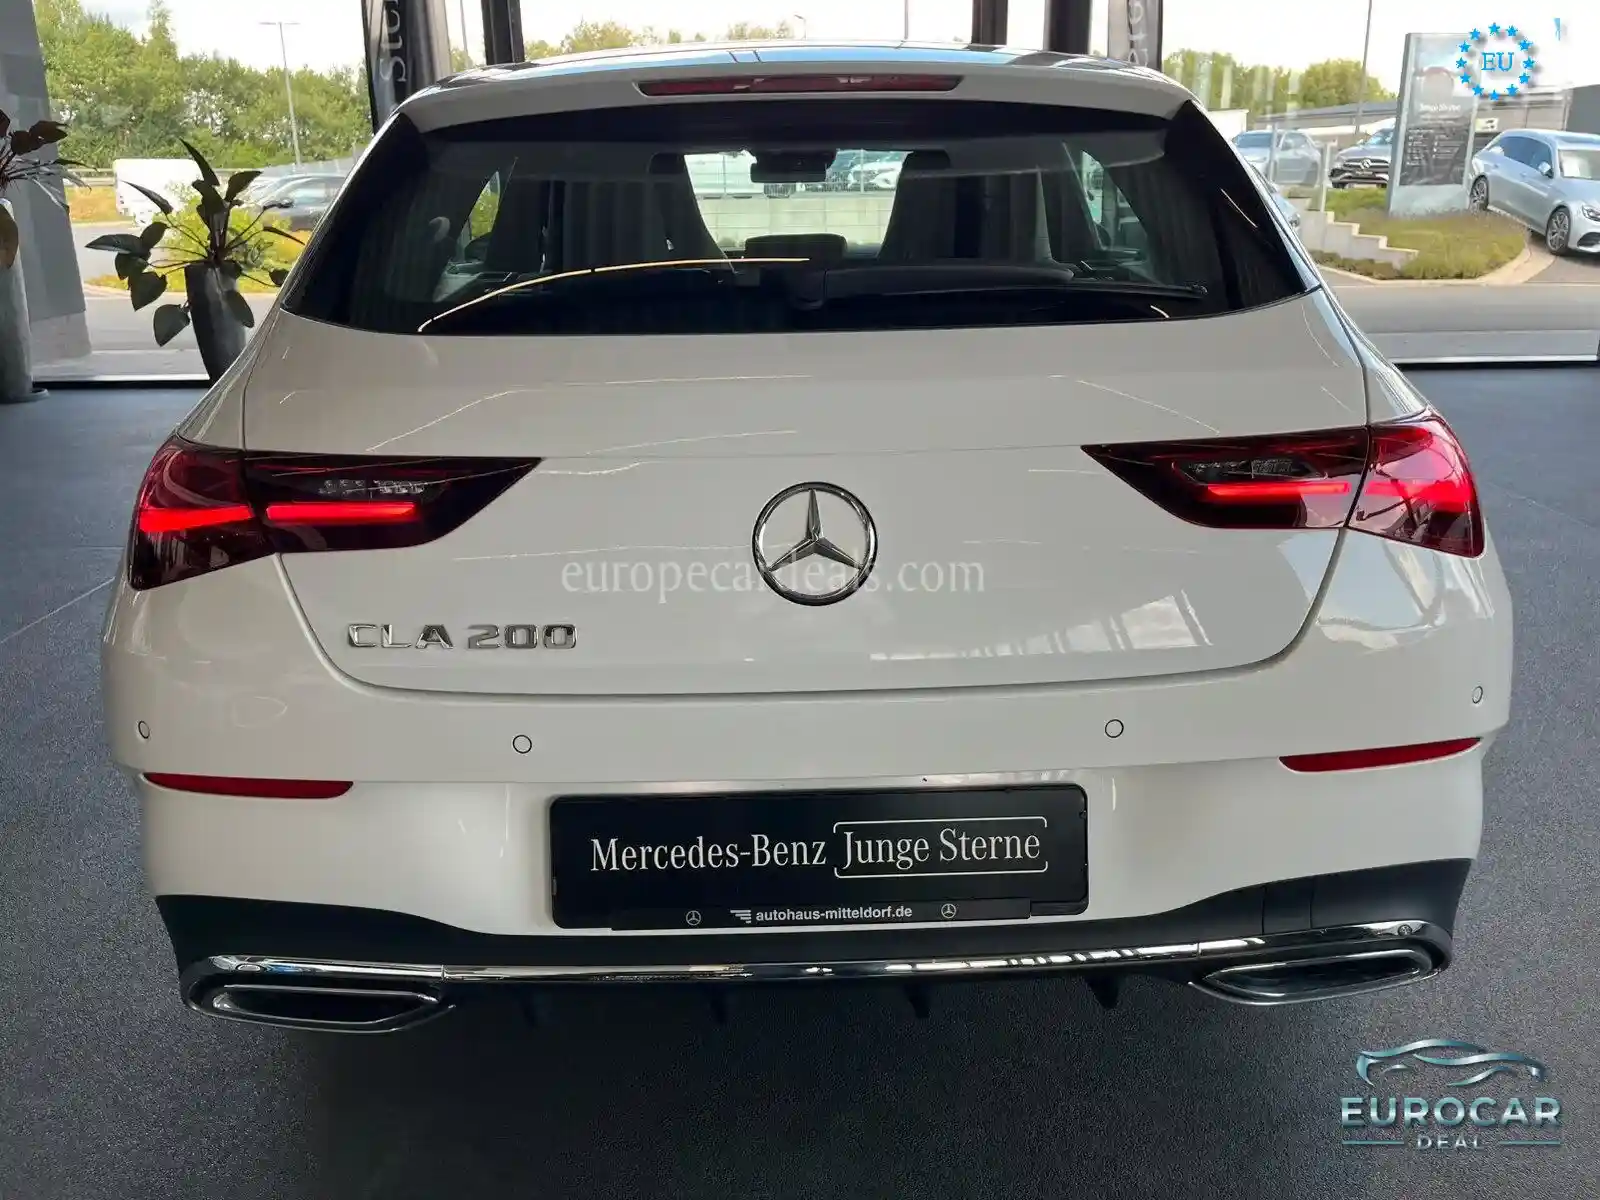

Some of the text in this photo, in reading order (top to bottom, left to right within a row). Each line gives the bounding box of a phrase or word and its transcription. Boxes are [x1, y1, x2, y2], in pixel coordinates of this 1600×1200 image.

[379, 0, 406, 82] Ste
[348, 624, 577, 649] CLA 200
[590, 827, 1041, 872] Mercedes-Benz Junge Sterne
[755, 905, 913, 922] autohaus-mitteldorf.de
